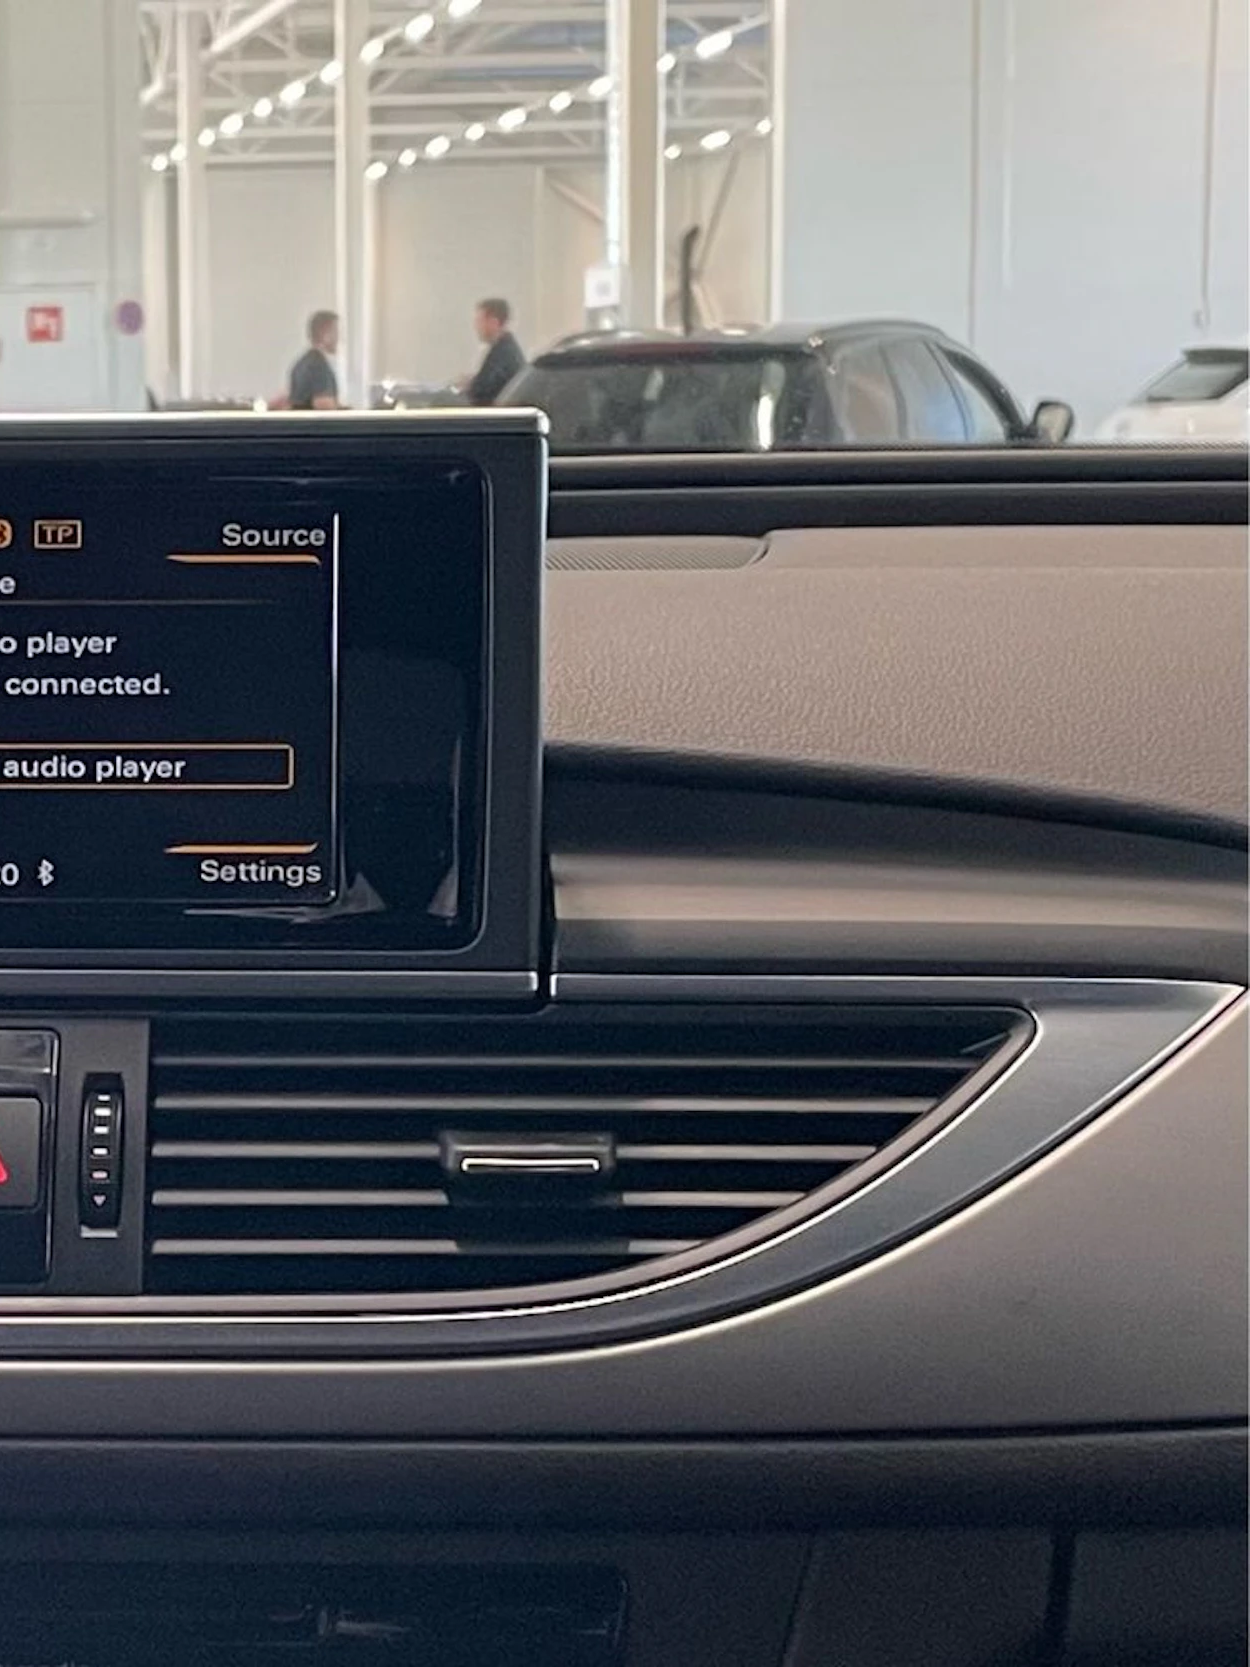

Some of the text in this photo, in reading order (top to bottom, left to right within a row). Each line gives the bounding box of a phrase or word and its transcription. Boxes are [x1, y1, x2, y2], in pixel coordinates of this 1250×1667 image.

[42, 525, 74, 543] TP
[223, 524, 325, 546] Source
[28, 632, 117, 657] player
[6, 673, 169, 694] connected.
[3, 755, 86, 777] audio
[96, 756, 186, 782] player
[201, 860, 321, 886] Settings
